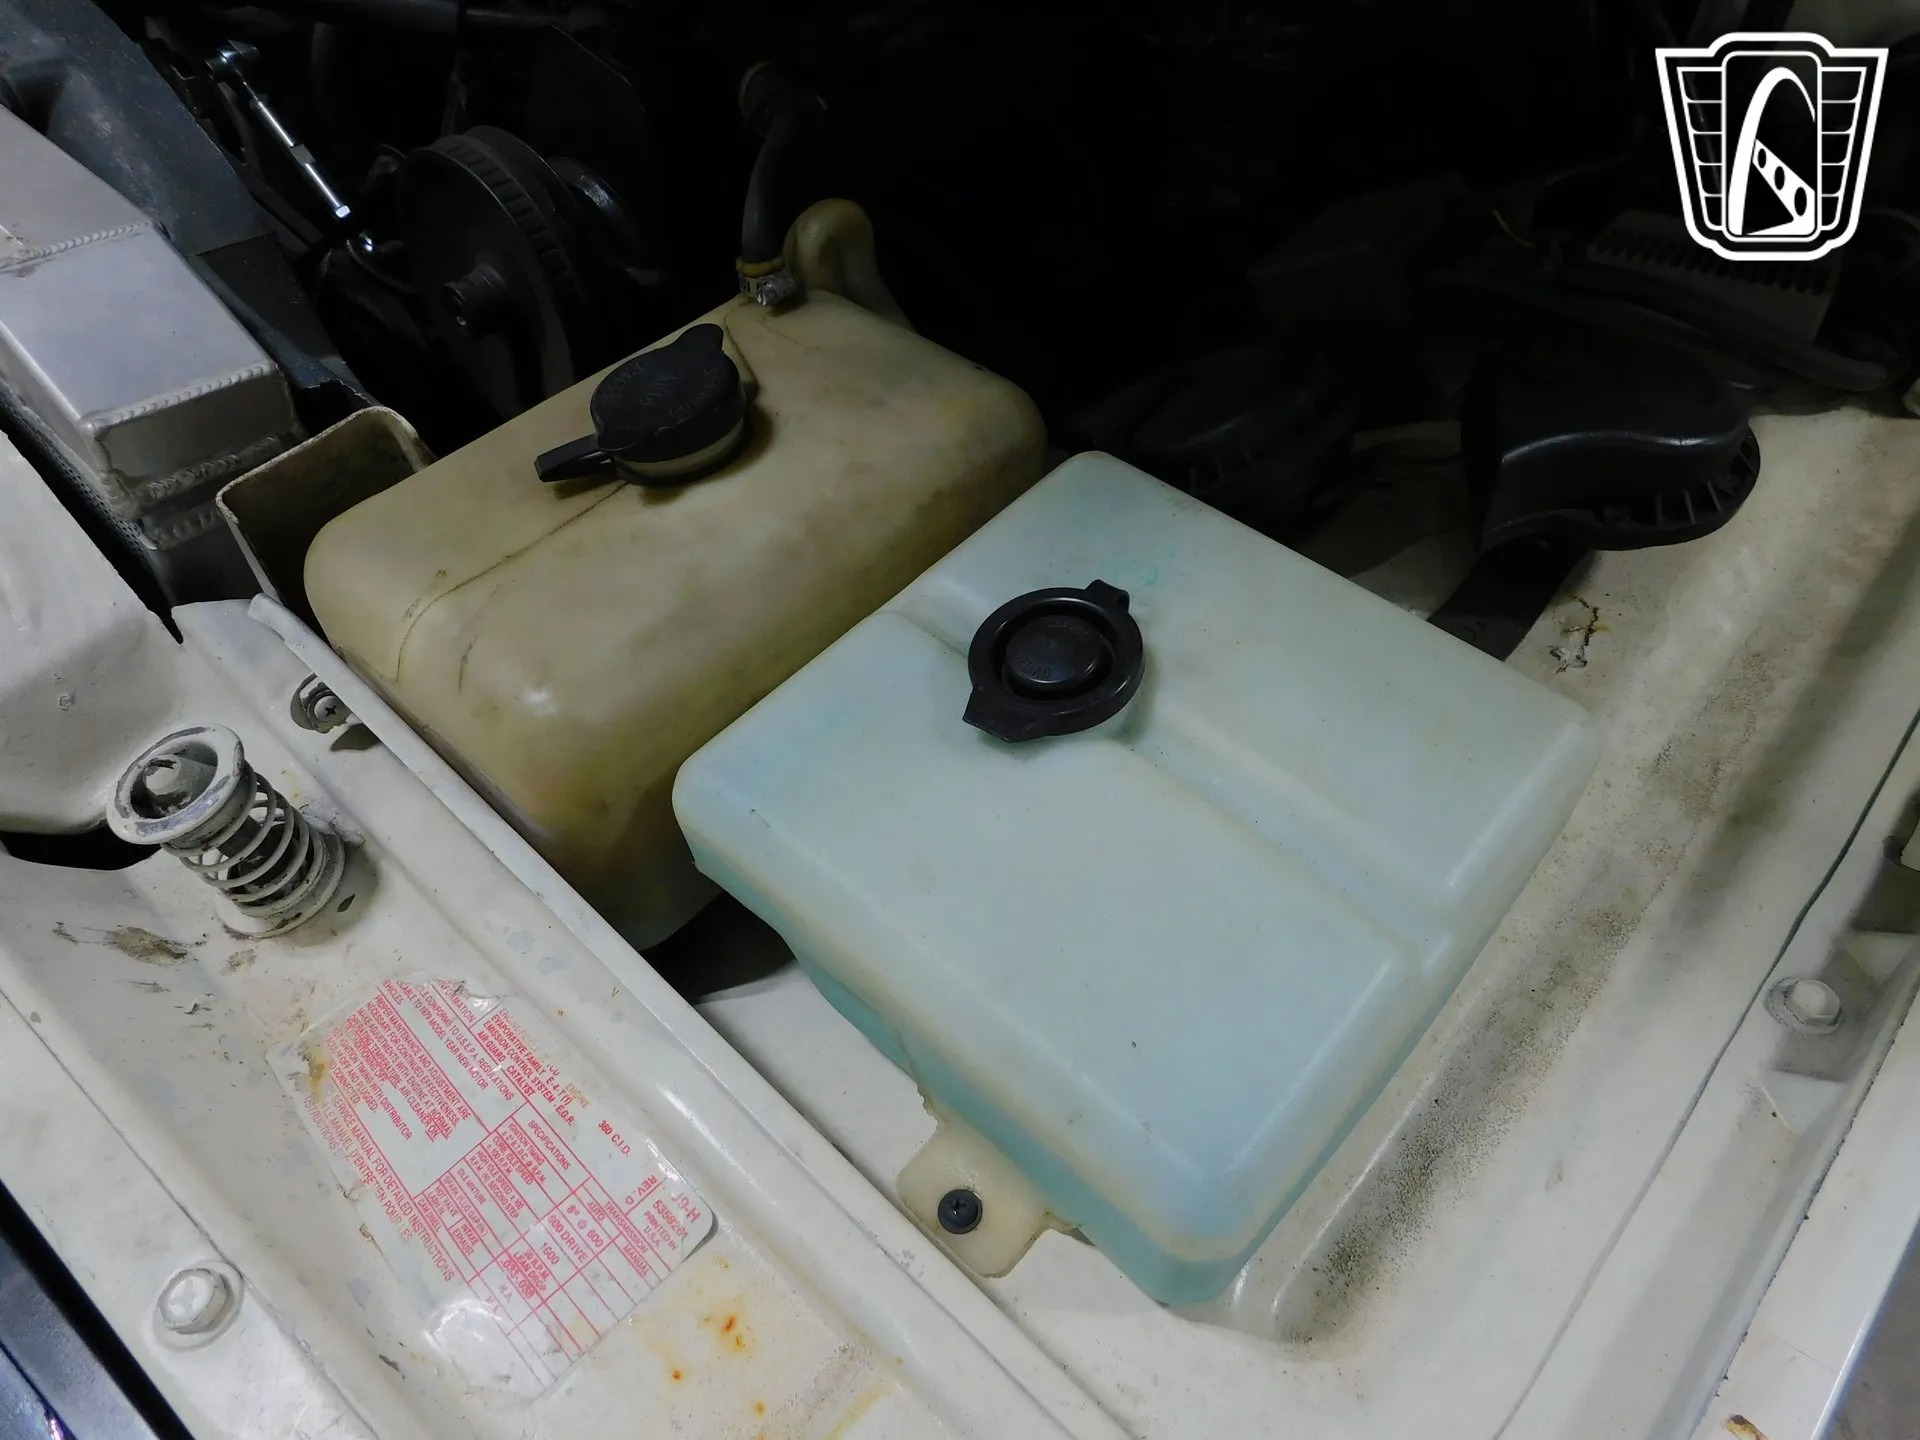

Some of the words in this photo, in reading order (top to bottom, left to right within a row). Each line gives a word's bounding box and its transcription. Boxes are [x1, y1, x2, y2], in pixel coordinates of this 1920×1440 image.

[363, 1000, 392, 1034] NECESSARY
[386, 1030, 401, 1046] FOR
[394, 1042, 426, 1079] CONTINUED
[372, 994, 393, 1018] PROPER
[386, 1014, 422, 1056] MAINTENANCE
[416, 1052, 432, 1069] AND
[425, 1065, 461, 1107] ADJUSTMENT
[454, 1102, 472, 1121] ARE
[423, 994, 454, 1028] CONFORMS
[475, 1057, 515, 1102] REGULATIONS
[426, 1017, 448, 1040] MODEL
[443, 1037, 461, 1056] YEAR
[454, 1051, 472, 1069] NEW
[465, 1065, 489, 1091] MOTOR
[482, 1019, 511, 1051] EMISSION
[505, 1047, 535, 1078] CONTROL
[529, 1075, 556, 1104] SYSTEM
[489, 1013, 528, 1054] EVAPORATIVE
[522, 1050, 547, 1076] FAMILY
[345, 1067, 361, 1084] AND
[366, 1022, 400, 1063] ADJUSTMENTS
[393, 1059, 411, 1079] WITH
[405, 1075, 428, 1102] ENGINE
[427, 1106, 455, 1138] NORMAL
[475, 1029, 489, 1043] AIR
[484, 1039, 507, 1063] GUARD
[504, 1063, 536, 1098] CATALYST
[354, 1060, 374, 1084] TIMING
[368, 1080, 385, 1100] WITH
[378, 1096, 414, 1141] DISTRIBUTOR
[397, 1084, 412, 1099] AIR
[405, 1094, 432, 1127] CLEANER
[327, 1116, 355, 1152] MANUEL
[506, 1121, 530, 1148] IGNITION
[525, 1144, 545, 1166] TIMING
[526, 1119, 572, 1171] SPECIFICATIONS
[329, 1093, 357, 1128] SERVICE
[349, 1123, 378, 1160] MANUAL
[370, 1156, 389, 1179] FOR
[381, 1174, 414, 1218] DETAILED
[405, 1212, 457, 1283] INSTRUCTIONS
[455, 1166, 469, 1182] IDLE
[474, 1148, 490, 1166] HIGH
[485, 1162, 499, 1178] IDLE
[494, 1174, 513, 1195] SPEED
[504, 1151, 519, 1168] IDLE
[514, 1164, 534, 1186] SPEED
[416, 1197, 430, 1214] CAM
[424, 1210, 443, 1233] DWELL
[433, 1184, 447, 1200] HOT
[441, 1197, 459, 1218] VALVE
[442, 1175, 460, 1198] SPARK
[455, 1193, 471, 1213] PLUG
[487, 1179, 509, 1206] SECOND
[504, 1202, 520, 1220] STEP
[451, 1227, 474, 1257] EXHAUST
[459, 1222, 479, 1246] INTAKE
[558, 1229, 589, 1264] DRIVE
[602, 1200, 649, 1255] TRANSMISSION
[641, 1209, 672, 1243] PRINTED
[512, 1249, 531, 1273] LEAN
[526, 1269, 547, 1294] DROP
[621, 1243, 651, 1276] MANUAL
